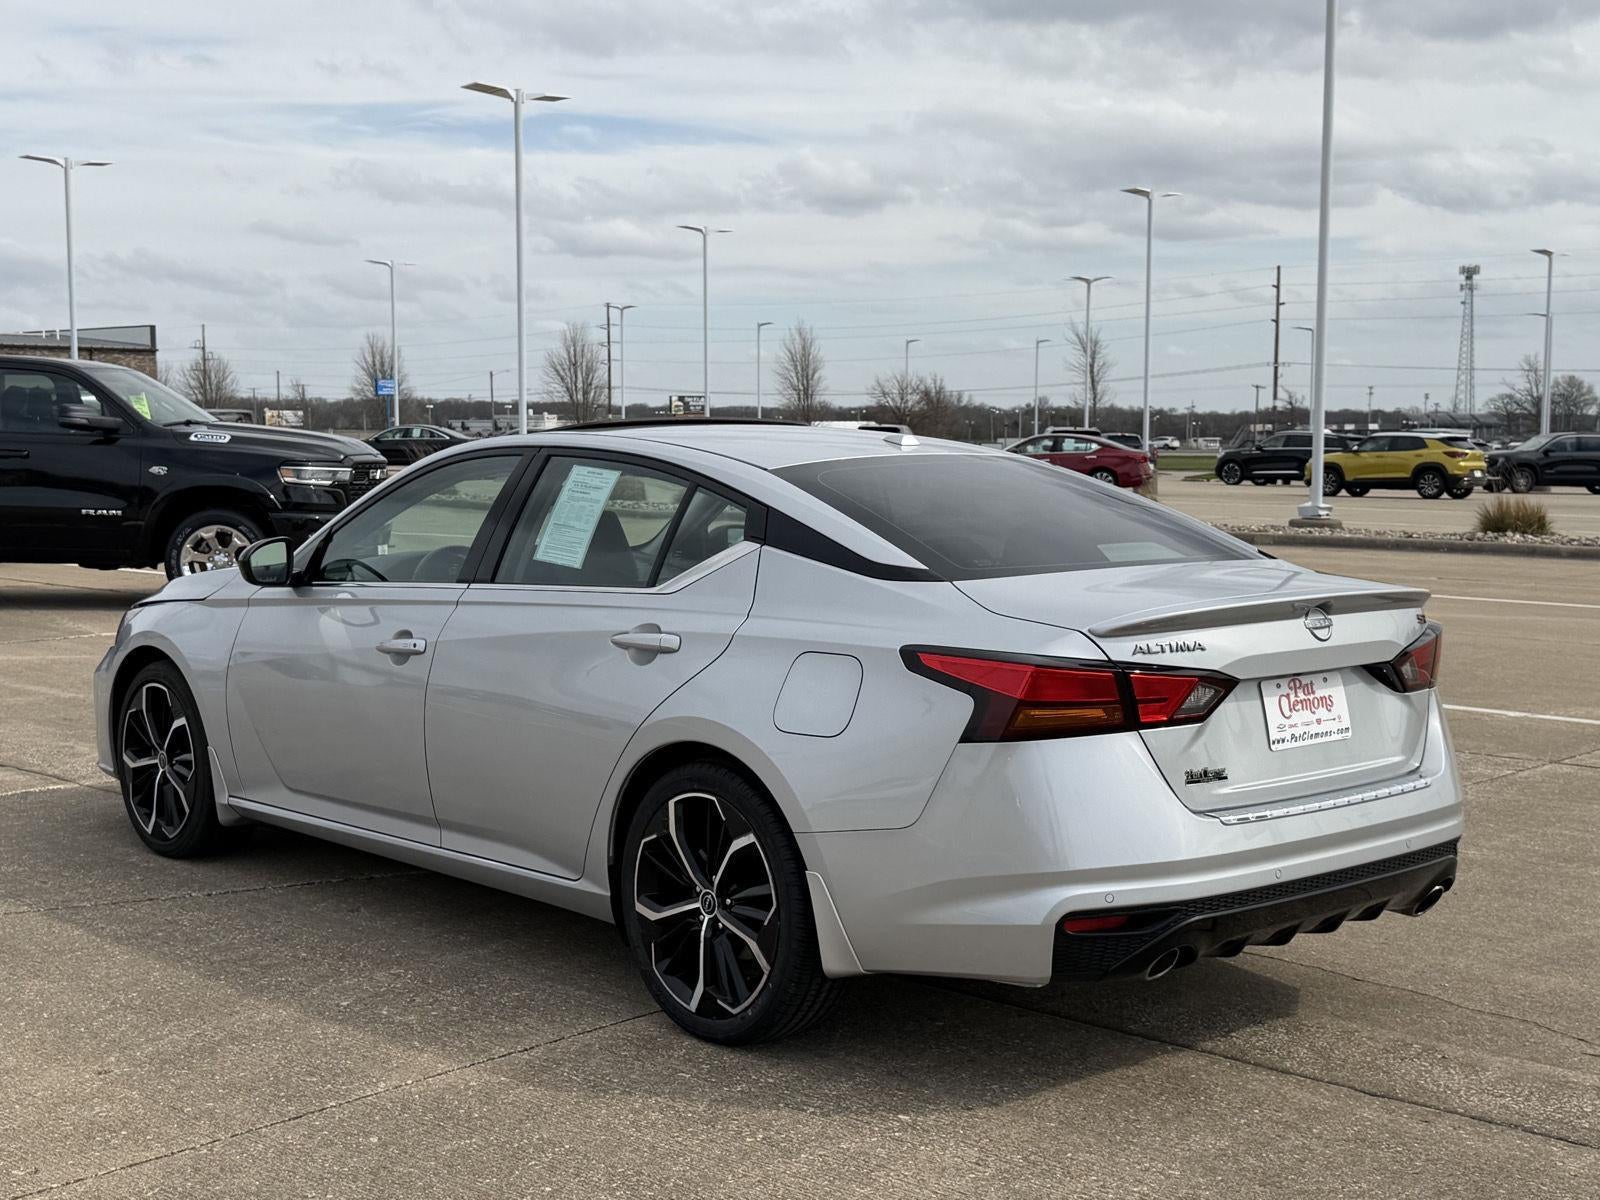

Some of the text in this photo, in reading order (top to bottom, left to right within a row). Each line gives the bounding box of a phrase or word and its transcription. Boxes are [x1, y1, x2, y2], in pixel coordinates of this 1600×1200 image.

[81, 508, 122, 516] RAM
[1132, 641, 1206, 656] ALTIMA
[1287, 678, 1316, 698] Pat
[1278, 693, 1334, 720] Clemons
[1271, 726, 1350, 745] www.PatClemons.com
